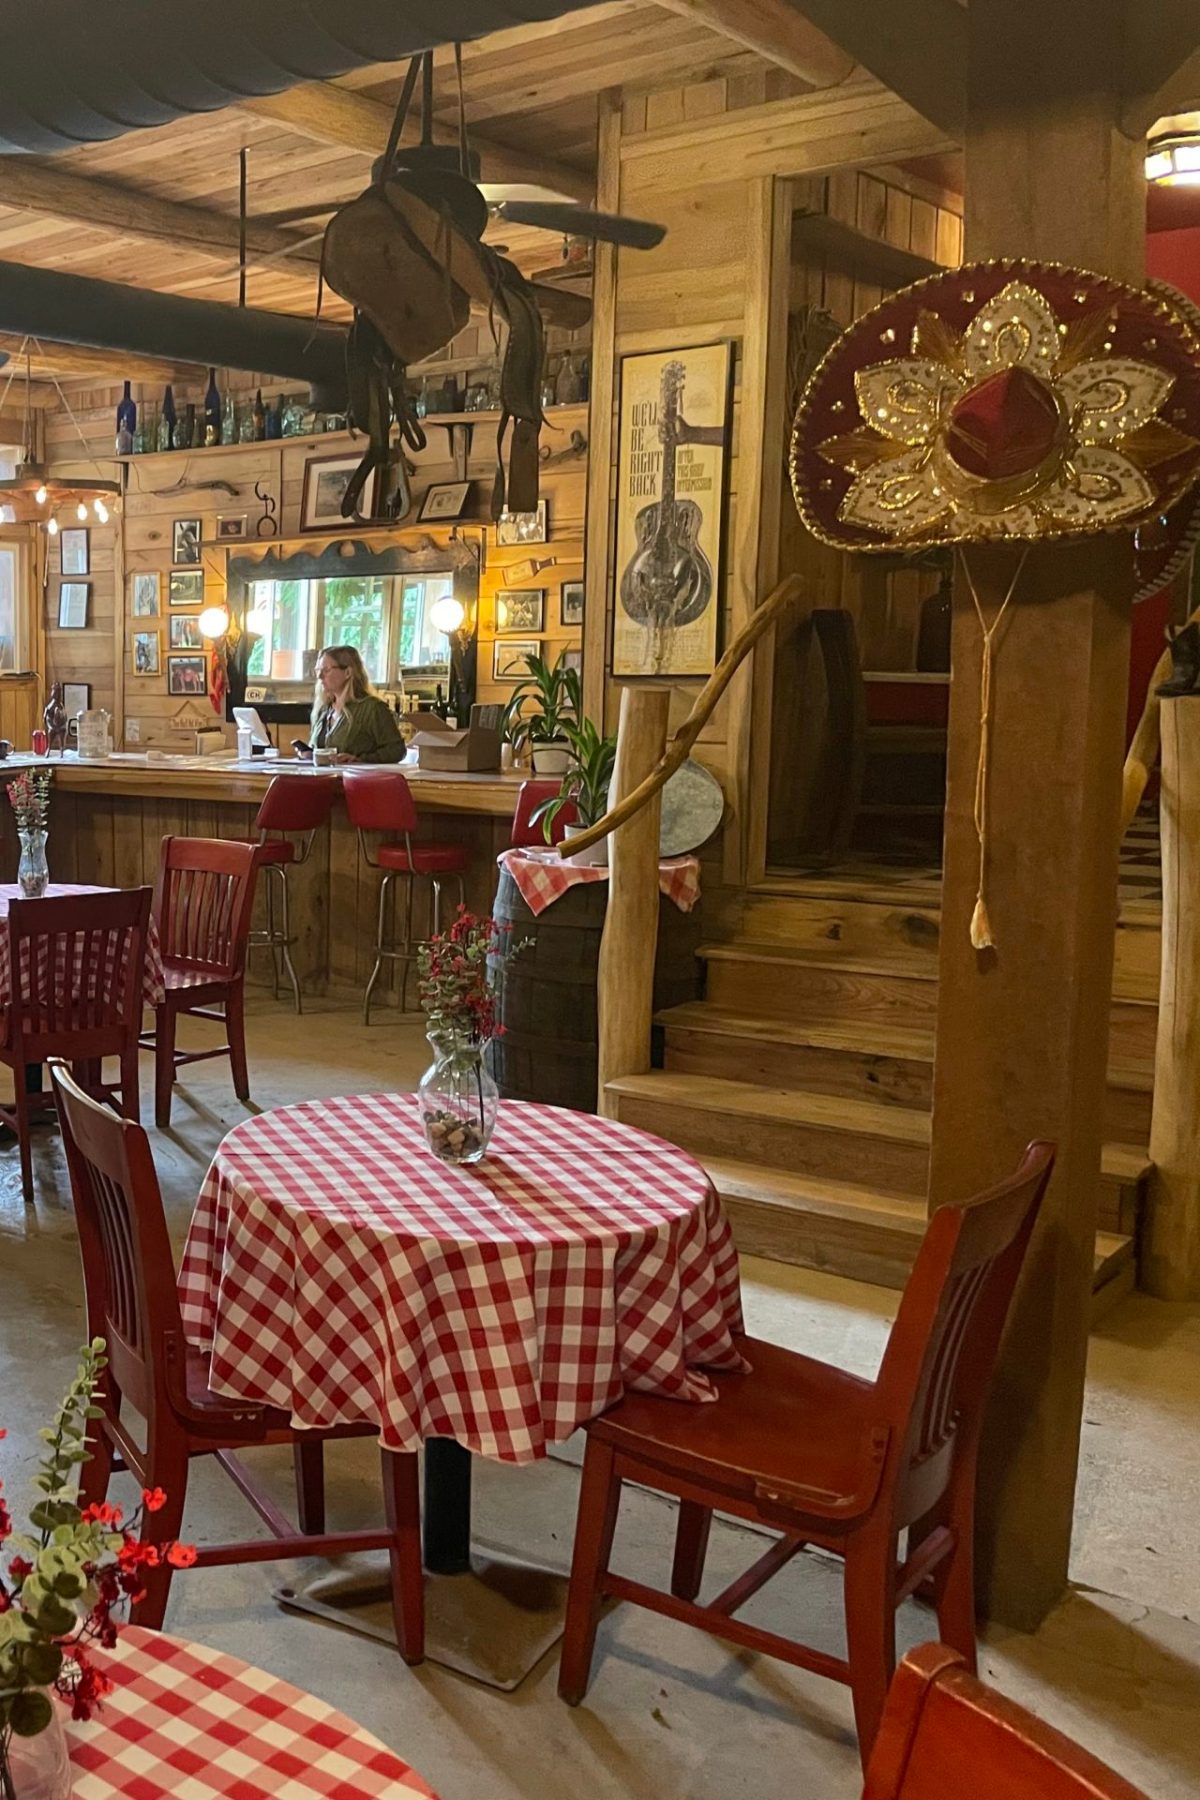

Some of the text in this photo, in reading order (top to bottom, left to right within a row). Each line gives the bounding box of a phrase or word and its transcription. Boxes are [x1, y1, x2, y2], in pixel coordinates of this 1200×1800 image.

[632, 401, 659, 427] WE'LL
[631, 429, 644, 452] BE
[631, 451, 663, 474] RIGHT
[629, 473, 656, 497] BACK
